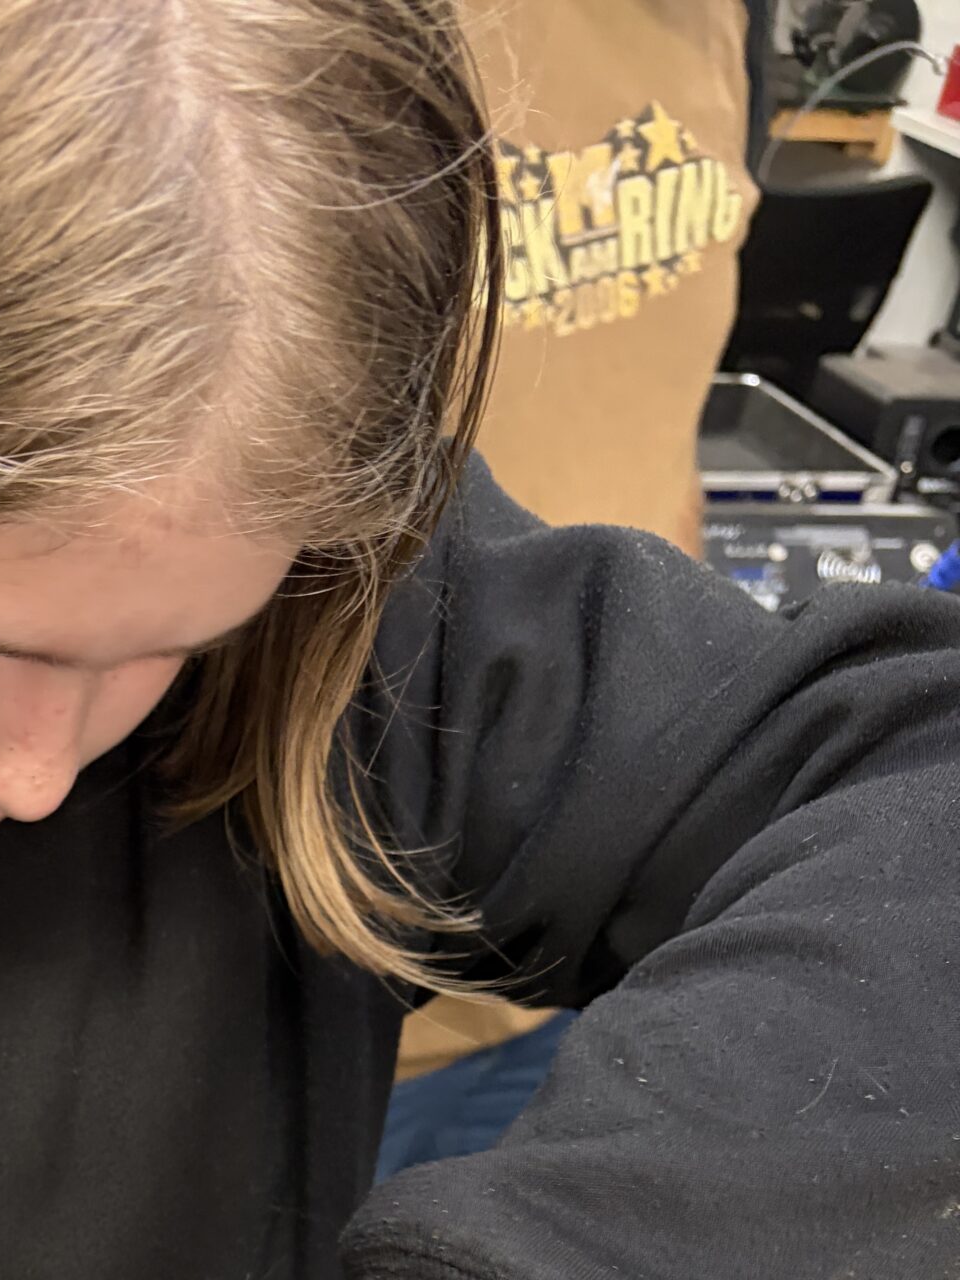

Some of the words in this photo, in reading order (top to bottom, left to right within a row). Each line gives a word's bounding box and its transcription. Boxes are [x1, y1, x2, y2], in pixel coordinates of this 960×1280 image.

[471, 198, 572, 309] CK
[617, 158, 742, 270] RING
[554, 270, 641, 337] 2006
